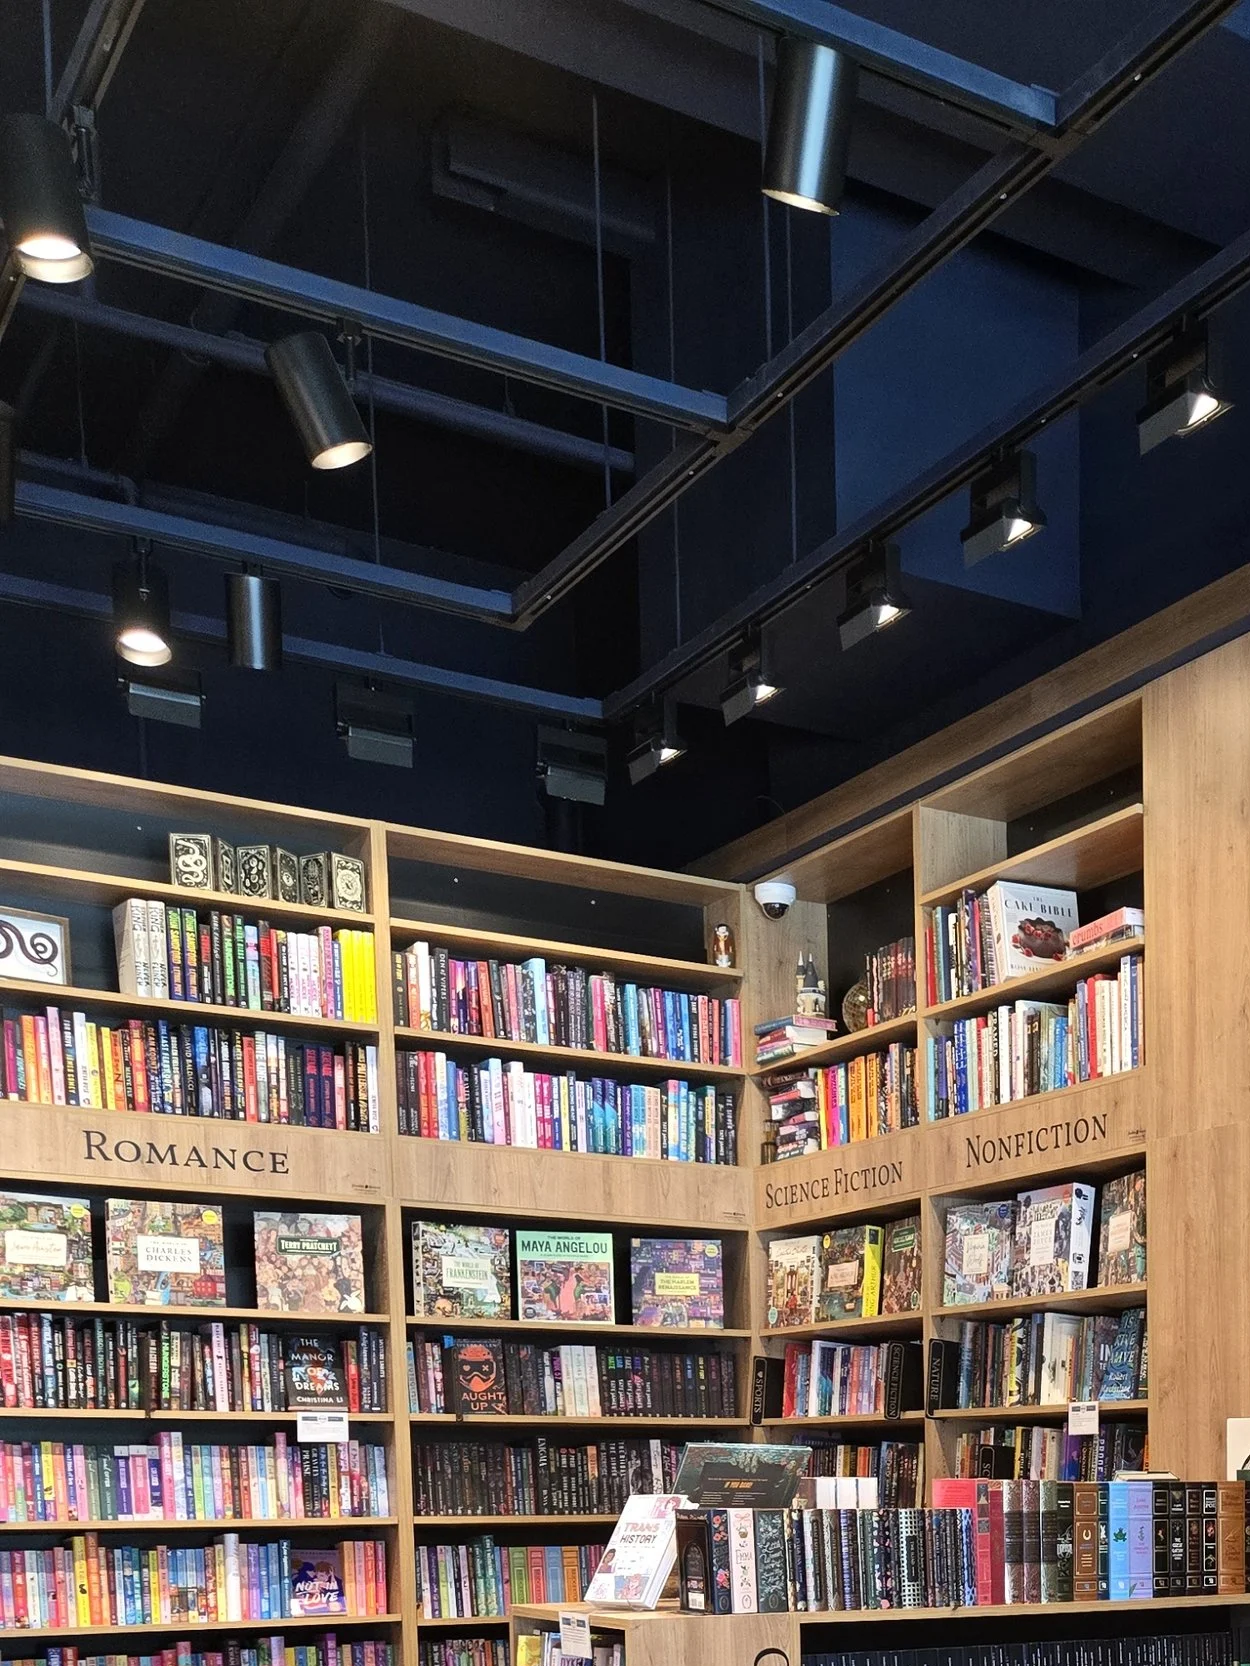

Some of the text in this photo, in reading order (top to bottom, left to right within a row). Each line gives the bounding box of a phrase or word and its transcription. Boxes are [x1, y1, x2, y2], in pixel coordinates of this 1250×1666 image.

[1004, 899, 1073, 918] CAKE BIBLE
[149, 906, 160, 933] KING
[966, 1113, 1108, 1168] NONFICTION
[82, 1130, 290, 1174] ROMANCE
[765, 1161, 903, 1210] SCIENCE FICTION
[145, 1245, 193, 1256] CHARLES
[280, 1239, 338, 1253] TERRY PRATCHETT
[521, 1239, 608, 1254] MAYA ANGELOU
[145, 1254, 193, 1264] DICKENS
[446, 1267, 489, 1281] FRANKENSTEIN
[300, 1338, 319, 1347] THE
[291, 1353, 334, 1362] MANOR
[294, 1381, 340, 1391] DREAMS
[930, 1357, 941, 1402] NATURE
[296, 1395, 334, 1404] CHRISTINA
[753, 1376, 763, 1416] SPORTS
[471, 1402, 488, 1411] UP
[623, 1521, 661, 1534] TRANS
[620, 1533, 658, 1546] HISTORY
[295, 1580, 323, 1594] NOT
[303, 1591, 340, 1604] LOVE
